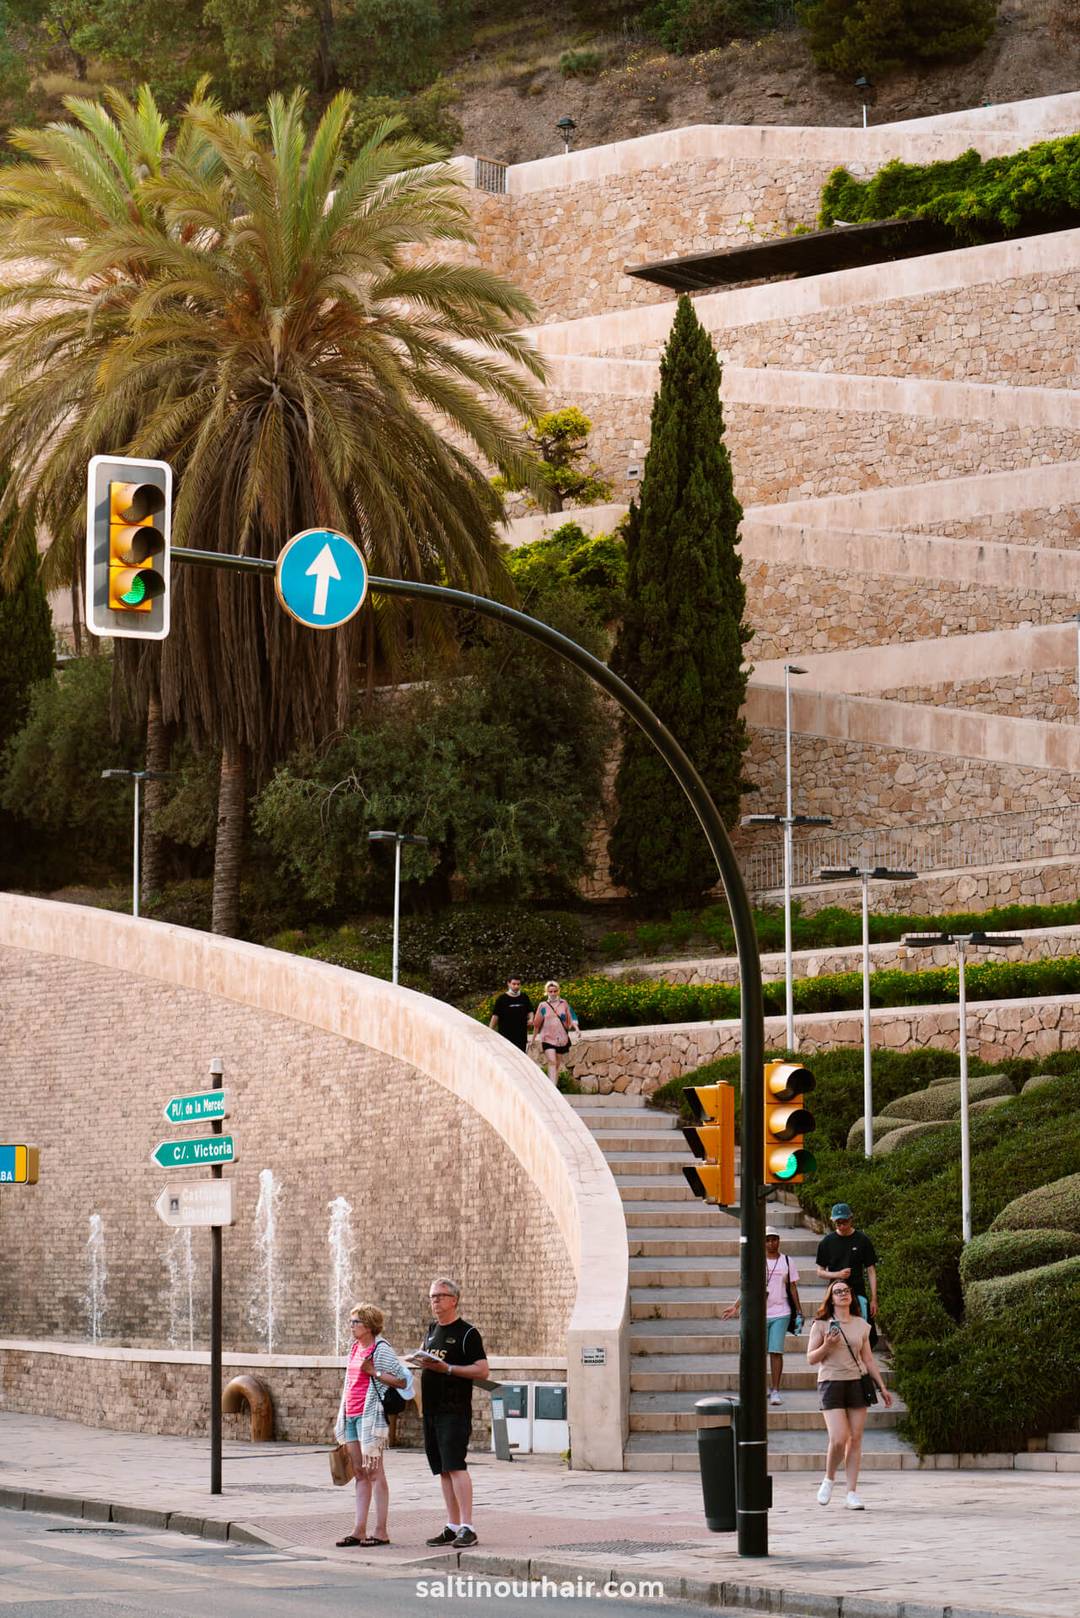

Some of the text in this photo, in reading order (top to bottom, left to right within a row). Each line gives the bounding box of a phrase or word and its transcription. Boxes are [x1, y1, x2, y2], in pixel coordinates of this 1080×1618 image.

[185, 1102, 193, 1115] de
[194, 1100, 202, 1113] la
[203, 1097, 225, 1112] Merced
[173, 1141, 233, 1160] C/. Victoria
[0, 1171, 13, 1182] BA
